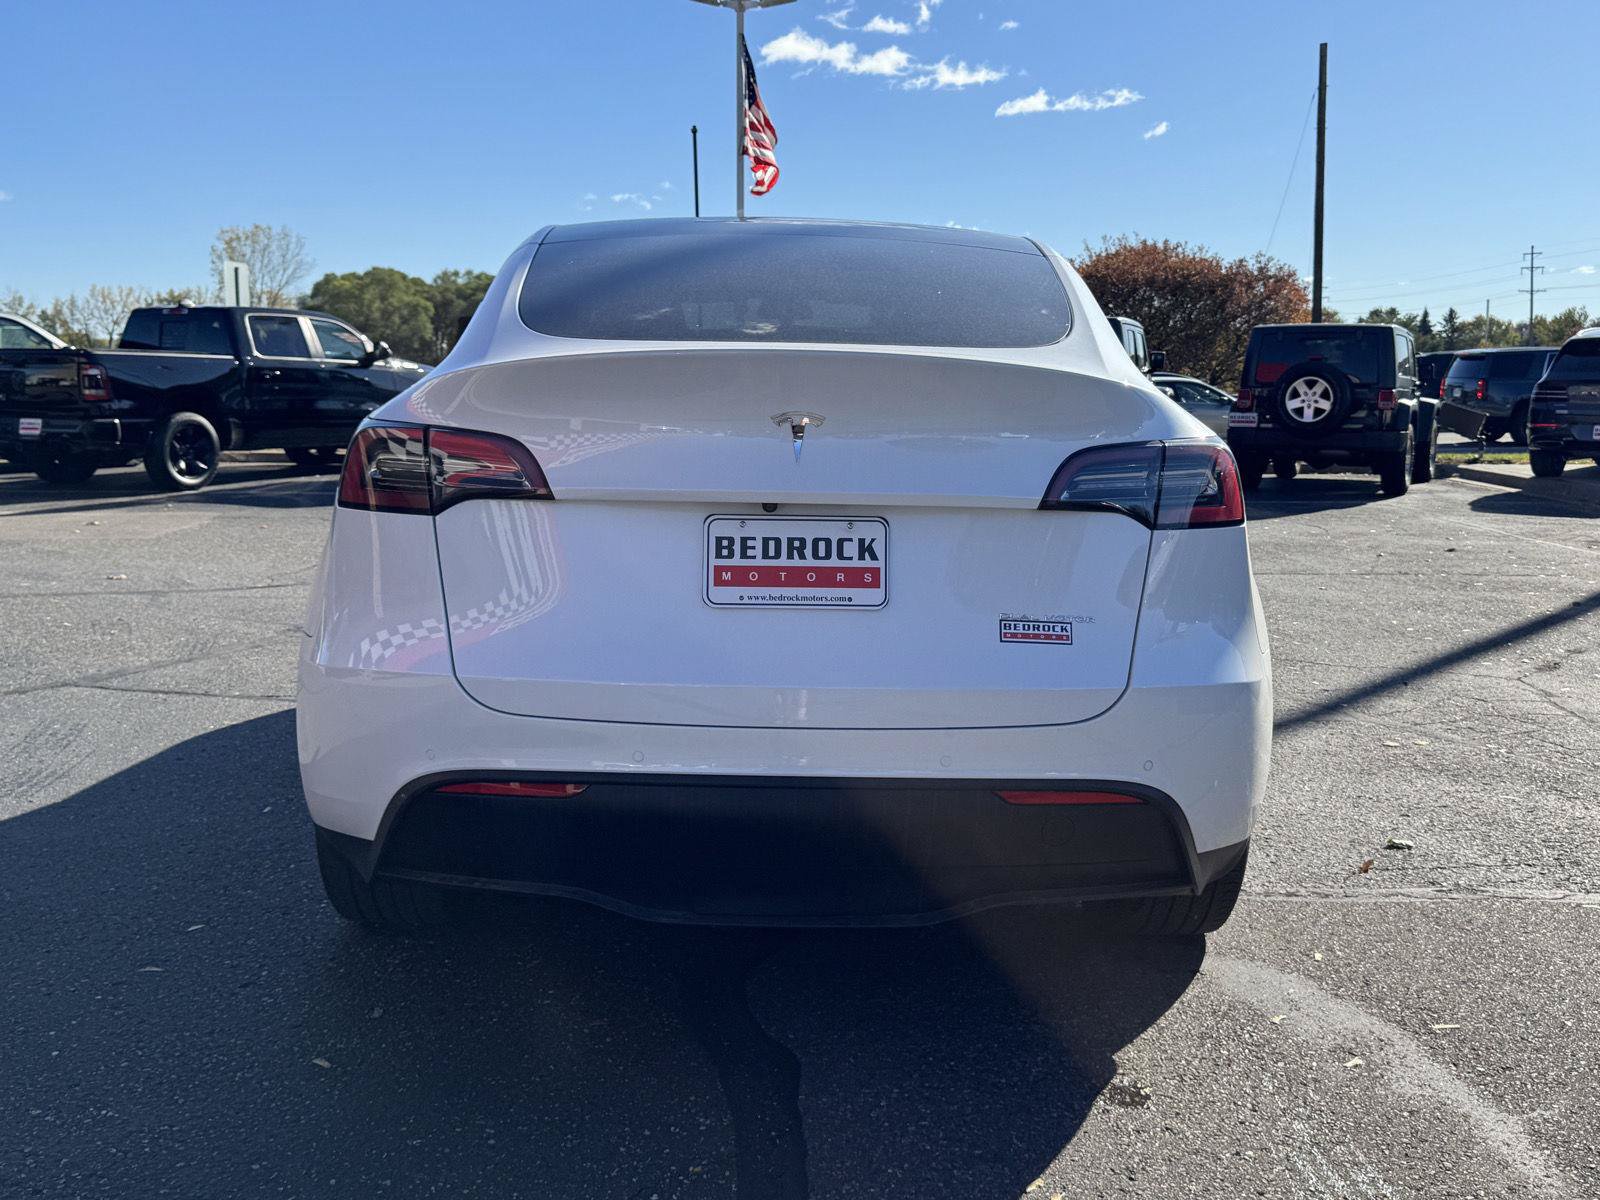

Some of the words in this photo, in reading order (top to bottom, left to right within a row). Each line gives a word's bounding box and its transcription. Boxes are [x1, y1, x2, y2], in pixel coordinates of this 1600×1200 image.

[714, 536, 880, 561] BEDROCK
[722, 571, 873, 583] MOTORS
[746, 593, 847, 603] www.bedrockmotors.com
[1003, 622, 1069, 633] BEDROCK
